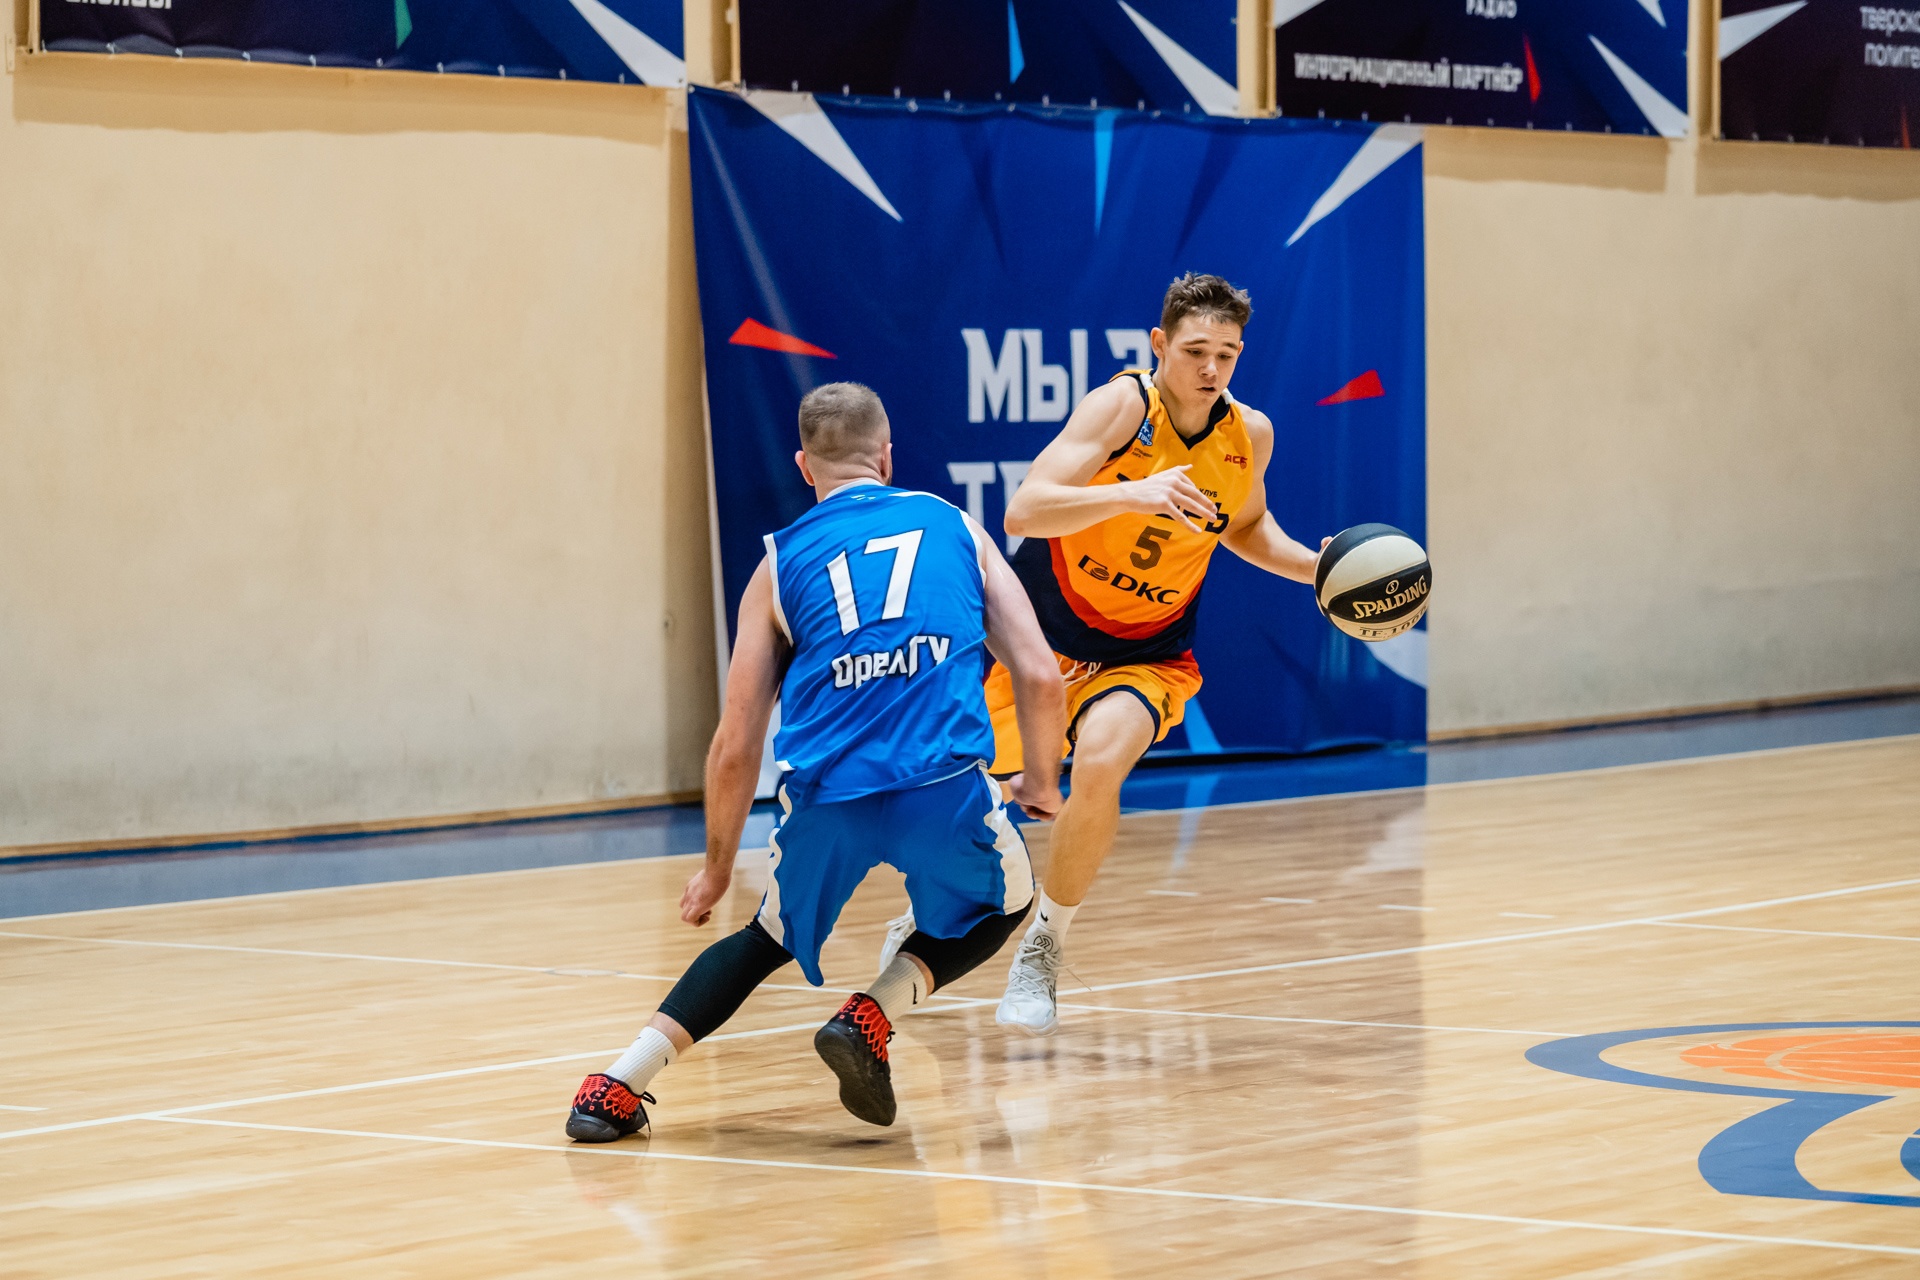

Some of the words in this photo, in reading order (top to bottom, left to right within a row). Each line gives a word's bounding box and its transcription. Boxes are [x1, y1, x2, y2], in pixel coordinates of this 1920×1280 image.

[1294, 53, 1450, 88] ИНФОРМАЦИОННЫЙ
[961, 328, 1088, 422] МЫ
[1129, 525, 1173, 571] 5
[827, 529, 924, 636] 17
[1110, 571, 1180, 605] DKC
[1352, 575, 1428, 619] SPALDING
